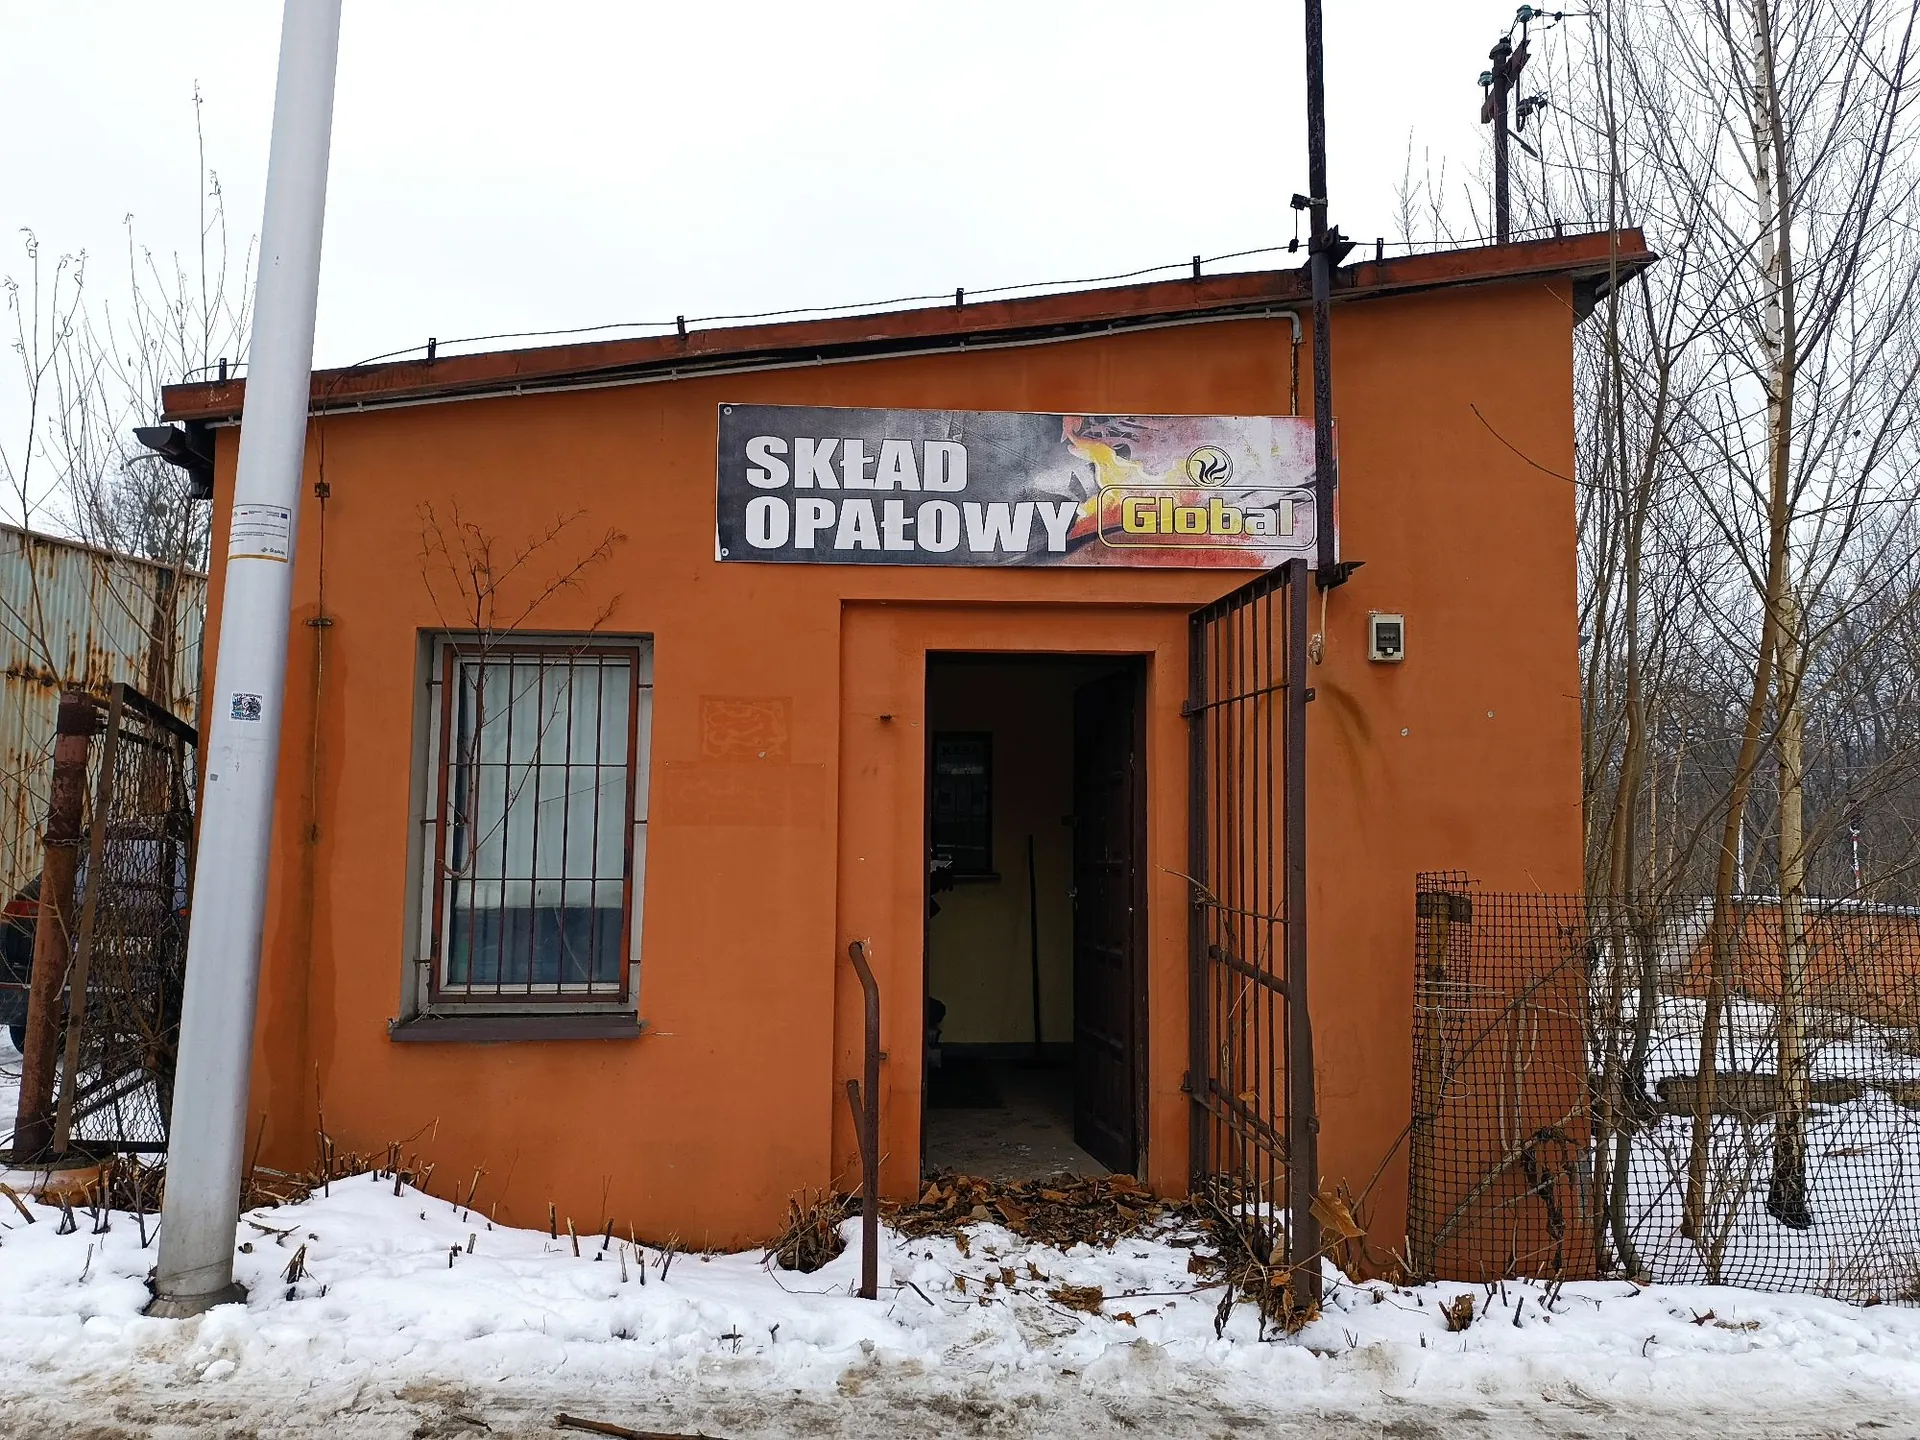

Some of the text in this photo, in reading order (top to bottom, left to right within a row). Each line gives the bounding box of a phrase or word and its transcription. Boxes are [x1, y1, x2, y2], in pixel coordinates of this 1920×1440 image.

[745, 435, 968, 493] SKŁAD
[745, 495, 1080, 553] OPAŁOWY
[1121, 494, 1295, 538] Global
